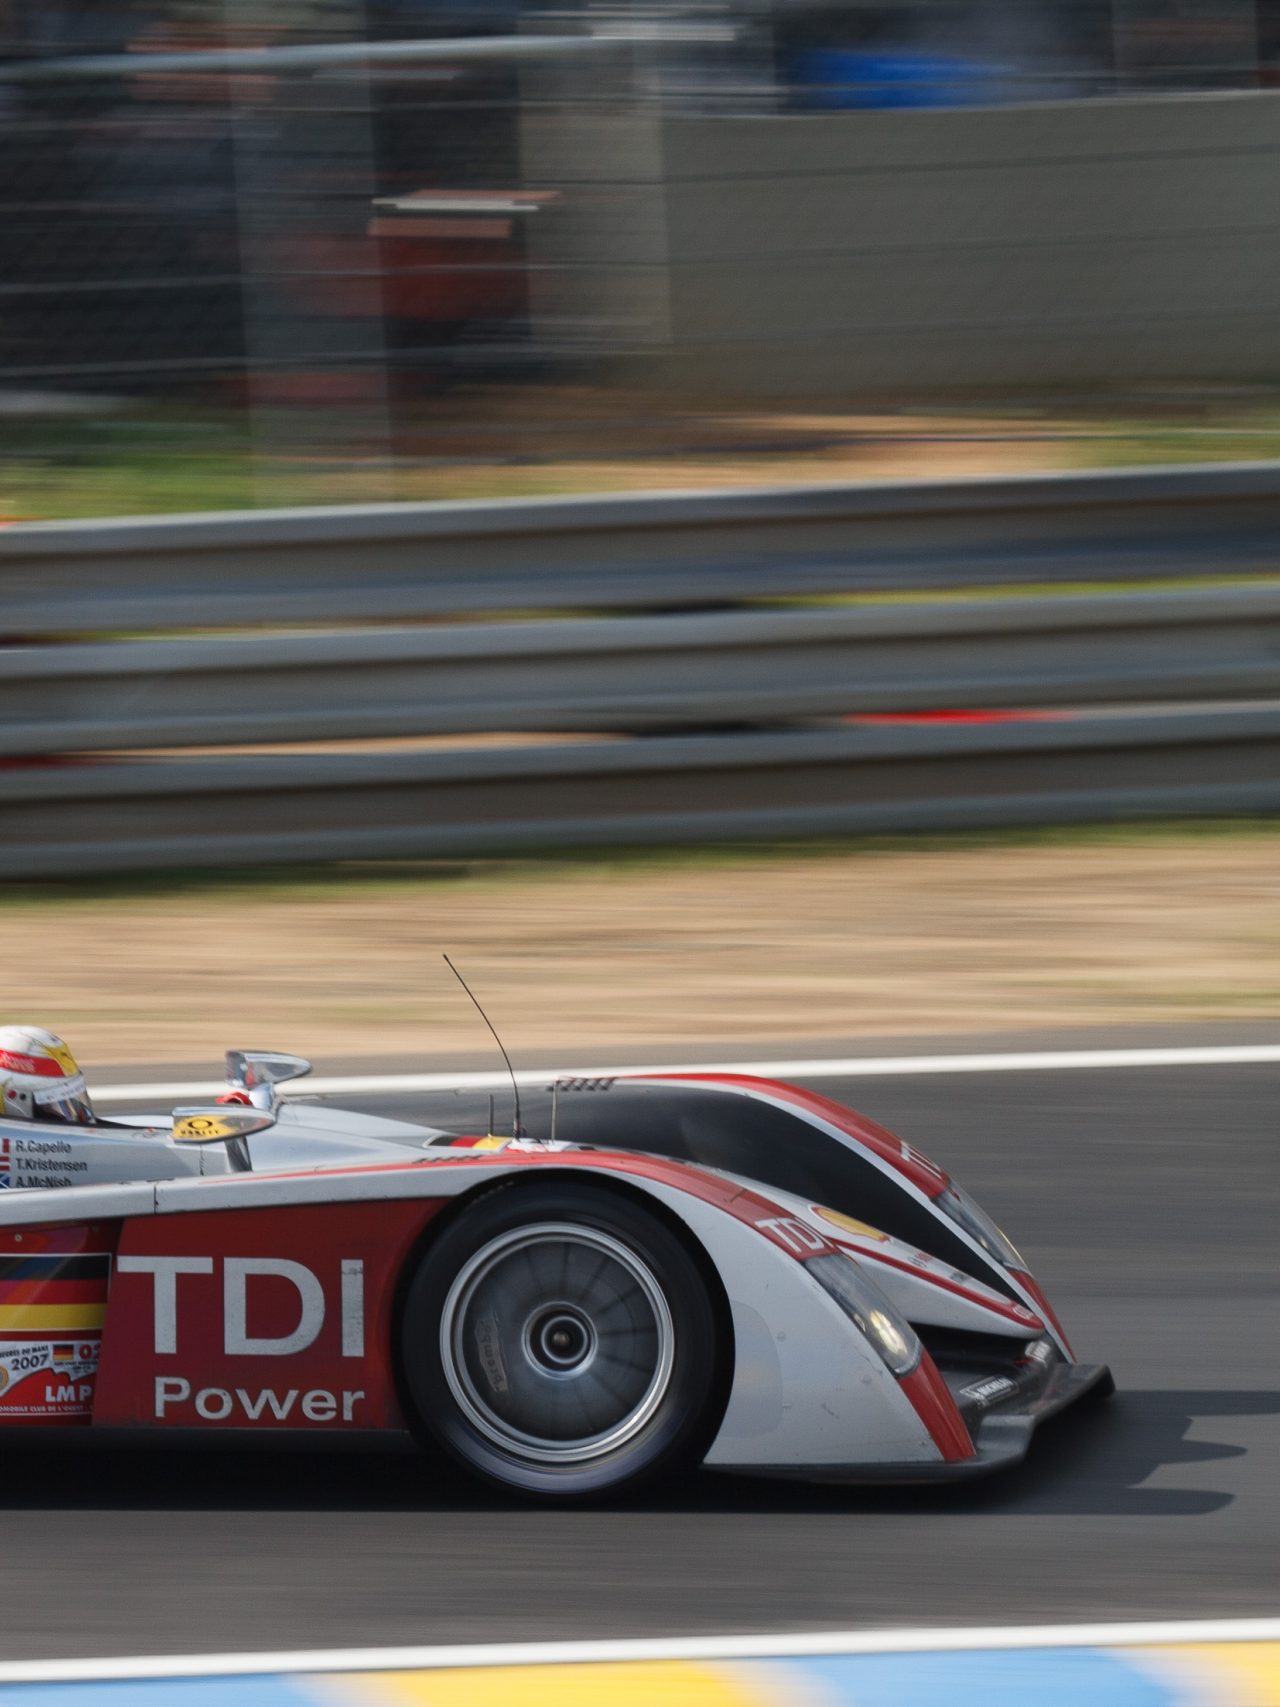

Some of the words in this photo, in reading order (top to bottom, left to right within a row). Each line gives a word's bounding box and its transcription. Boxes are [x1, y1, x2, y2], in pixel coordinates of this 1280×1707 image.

[16, 1140, 72, 1154] R.Capello
[16, 1158, 88, 1171] T.Kristensen
[117, 1255, 365, 1357] TDI
[11, 1353, 49, 1371] 2007
[155, 1376, 365, 1421] Power
